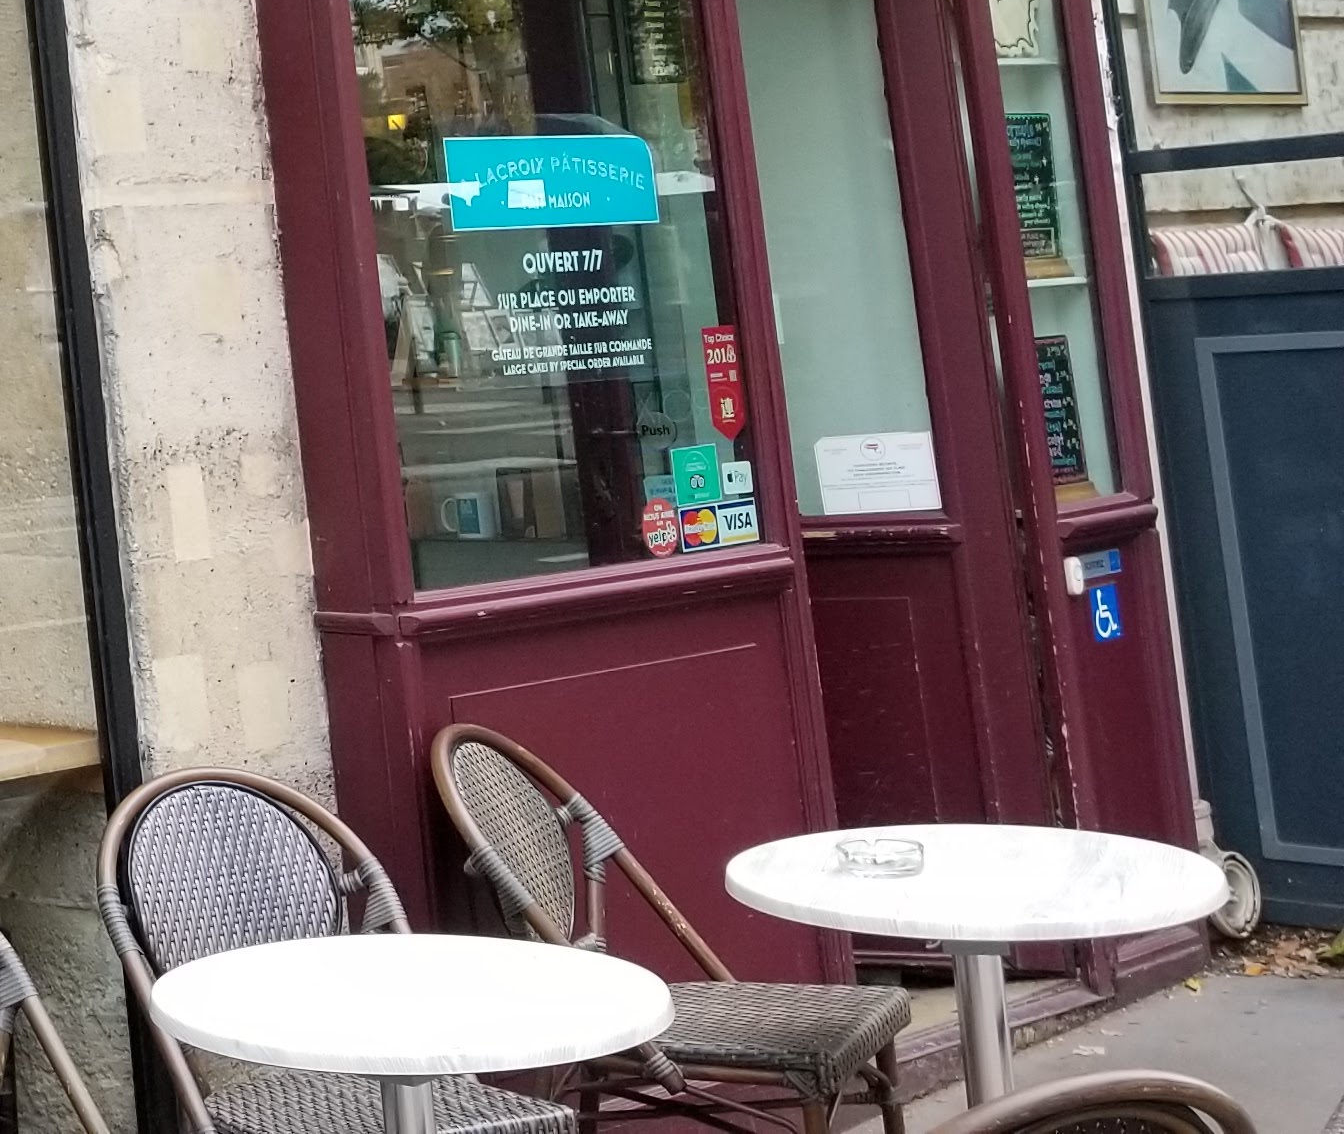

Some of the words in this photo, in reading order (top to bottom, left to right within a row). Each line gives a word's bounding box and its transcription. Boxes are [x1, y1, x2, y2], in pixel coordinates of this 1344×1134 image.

[548, 191, 591, 209] MAISON
[522, 250, 579, 274] OUVERT
[582, 248, 603, 272] 7/7
[497, 292, 518, 310] SUR
[520, 289, 556, 309] PLACE
[558, 289, 576, 306] OU
[579, 286, 637, 305] EMPORTER
[510, 314, 551, 333] DINE-IN
[553, 313, 572, 330] OR
[573, 309, 629, 329] TAKE-AWAY
[523, 346, 535, 359] DE
[535, 343, 569, 358] GRANDE
[569, 342, 593, 356] TAILLE
[593, 341, 609, 354] SUR
[609, 338, 653, 353] COMMANDE
[503, 363, 527, 376] LARGE
[549, 360, 559, 373] BY
[559, 358, 587, 372] SPECIAL
[587, 356, 611, 370] ORDER
[641, 423, 671, 437] Push
[722, 511, 753, 531] VISA
[648, 530, 668, 548] yelp
